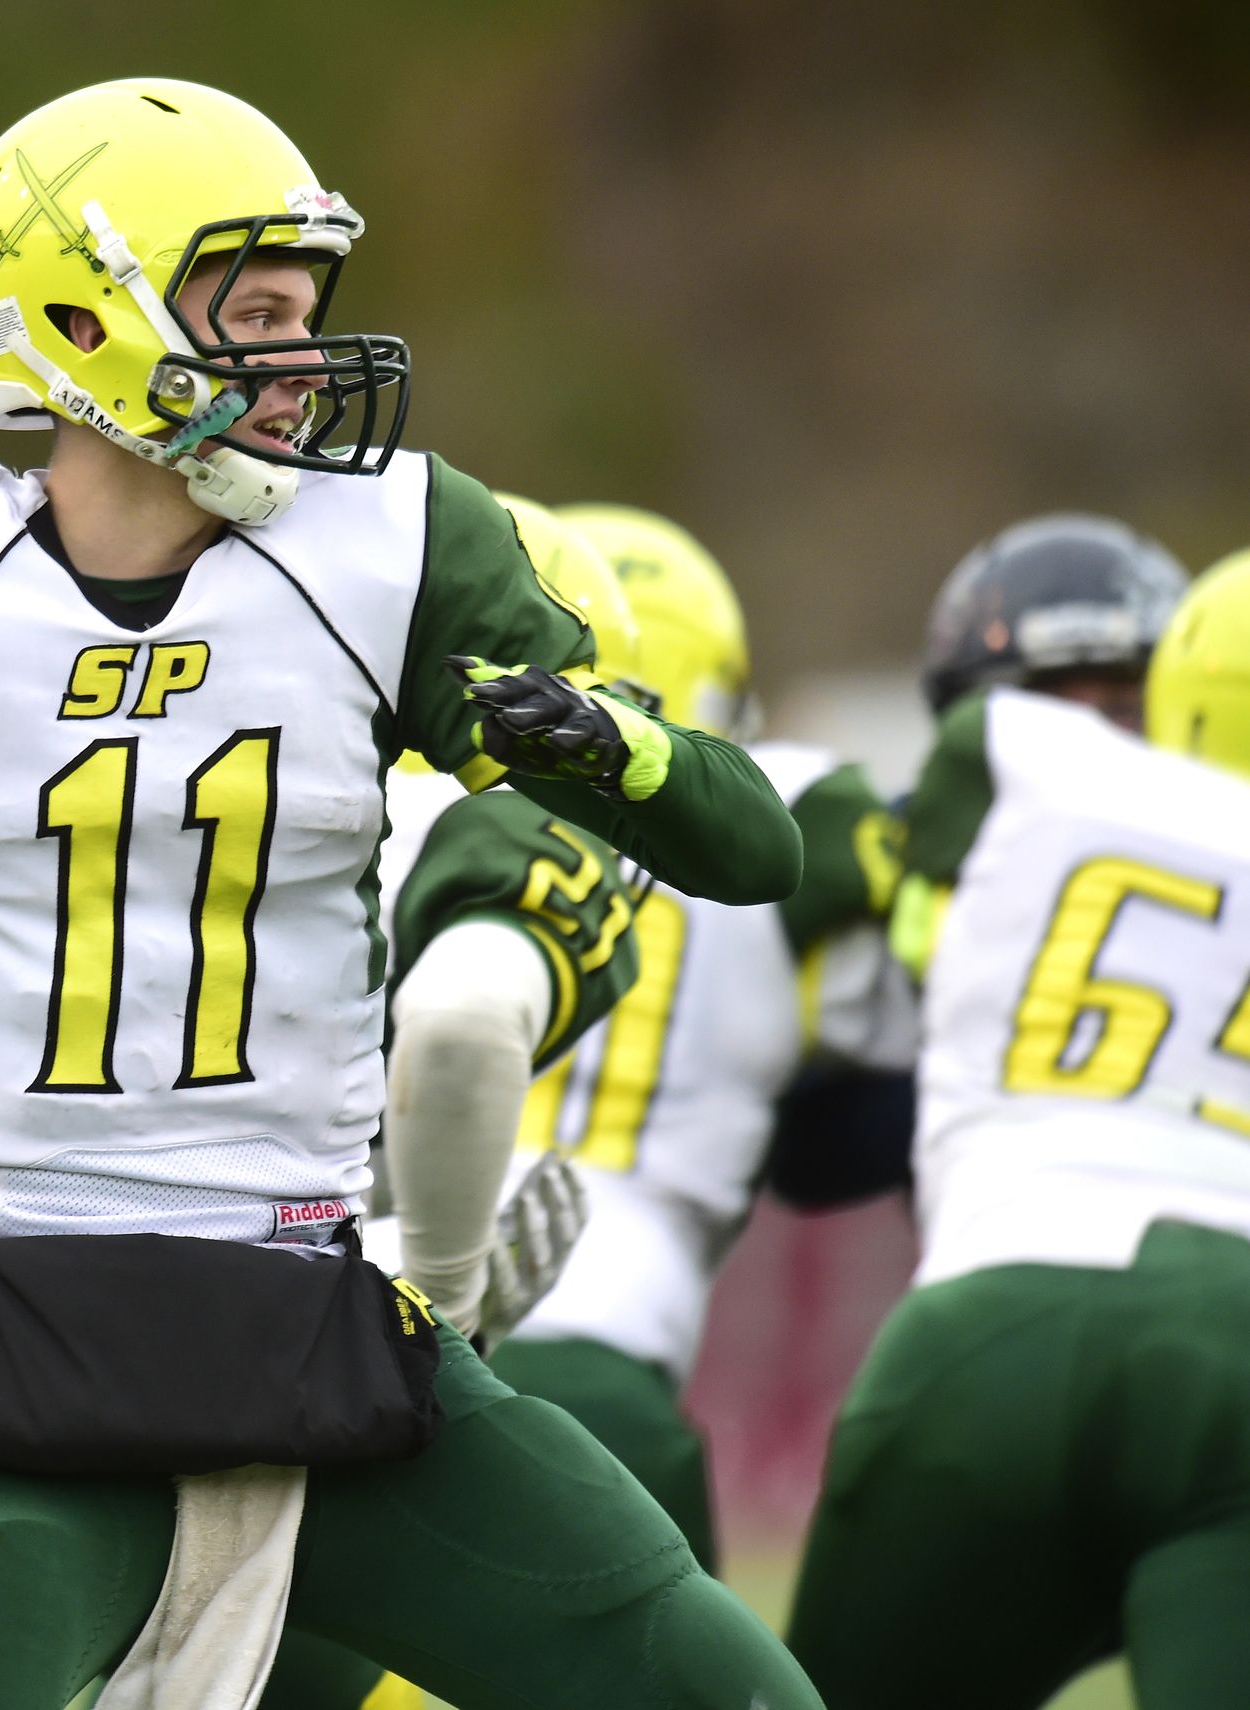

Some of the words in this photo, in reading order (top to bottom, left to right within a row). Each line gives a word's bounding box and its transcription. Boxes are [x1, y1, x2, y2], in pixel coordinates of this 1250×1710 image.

[55, 390, 124, 438] ADAMS
[57, 640, 211, 720] SP
[29, 725, 282, 1094] 11
[998, 855, 1250, 1140] 6
[279, 1200, 347, 1224] Riddell
